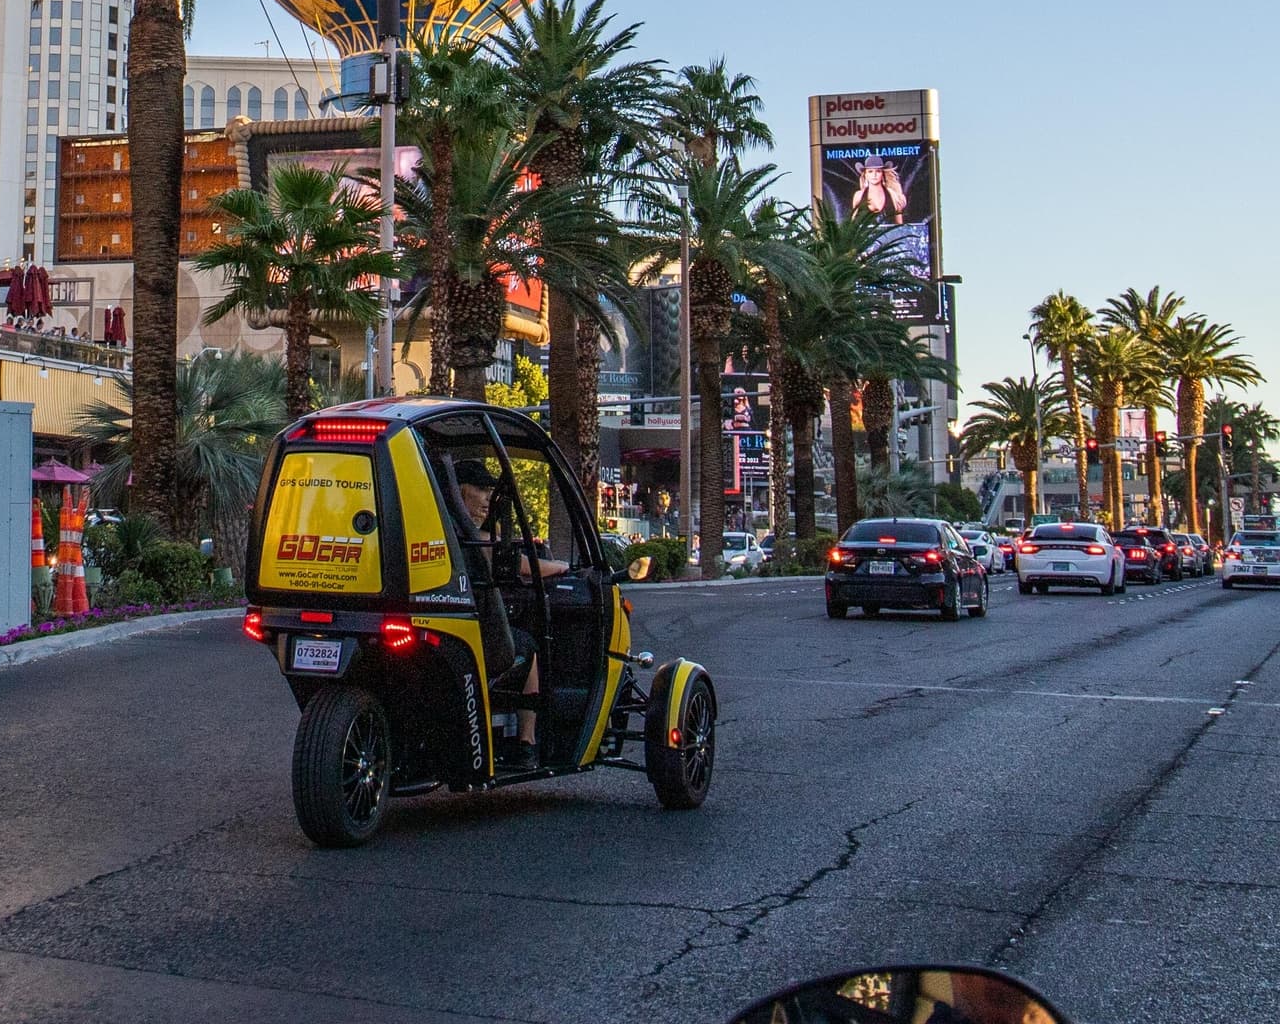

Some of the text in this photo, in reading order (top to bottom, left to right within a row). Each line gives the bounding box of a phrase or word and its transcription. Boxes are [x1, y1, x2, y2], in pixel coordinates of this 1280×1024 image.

[825, 95, 885, 117] planet
[826, 118, 918, 139] hollywood
[826, 146, 921, 160] MIRANDA LAMBERT
[648, 417, 681, 426] hollywoo
[280, 478, 372, 491] GPS GUIDED TOURS!
[278, 569, 358, 582] www.GoCarTours.com
[289, 580, 345, 590] 1-800-91-GoCar
[459, 575, 468, 593] 12
[415, 593, 472, 605] www.GoCarTours.com
[297, 647, 339, 660] 0732824
[463, 673, 482, 770] ARCIMOTO
